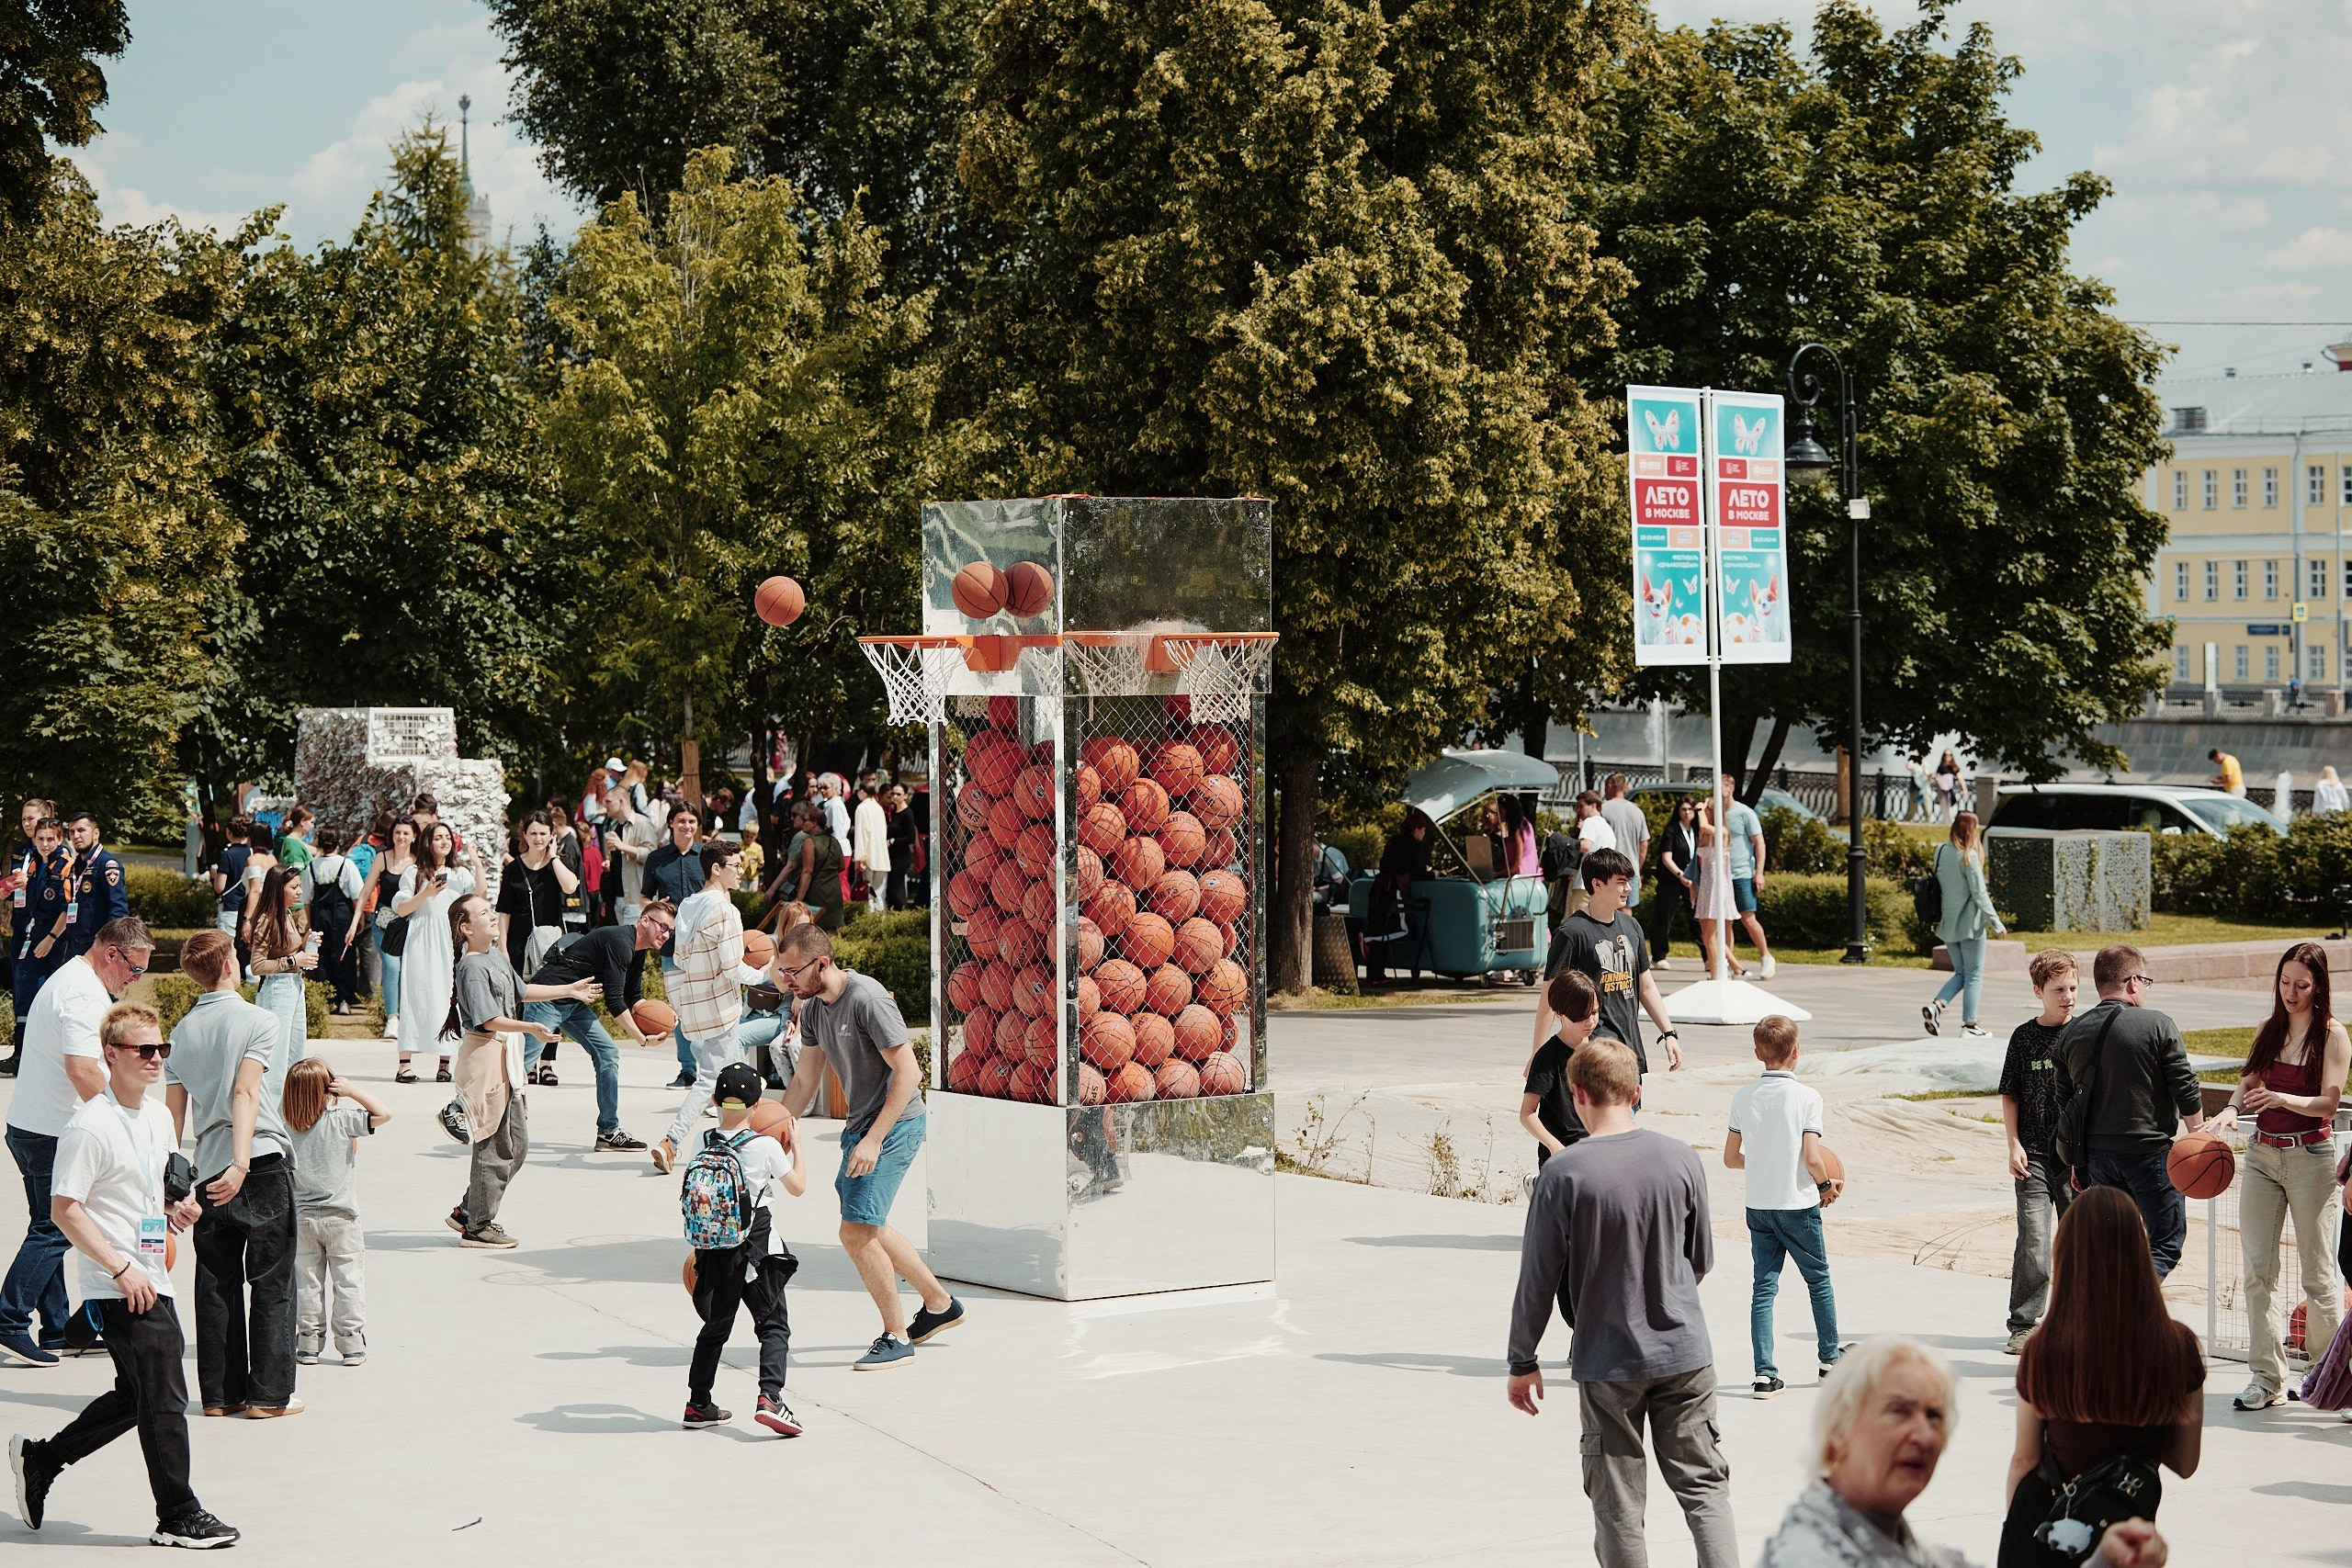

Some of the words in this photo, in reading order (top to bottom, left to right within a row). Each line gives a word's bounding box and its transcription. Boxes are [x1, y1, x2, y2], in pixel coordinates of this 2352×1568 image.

[1645, 486, 1690, 506] ЛЕТО
[1728, 489, 1770, 508] ЛЕТО
[1645, 508, 1652, 518] В
[1654, 508, 1690, 519] МОСКВЕ
[1728, 510, 1735, 520] В
[1736, 511, 1770, 521] МОСКВЕ
[957, 798, 980, 823] SPORT
[1604, 979, 1634, 993] DISTRICT
